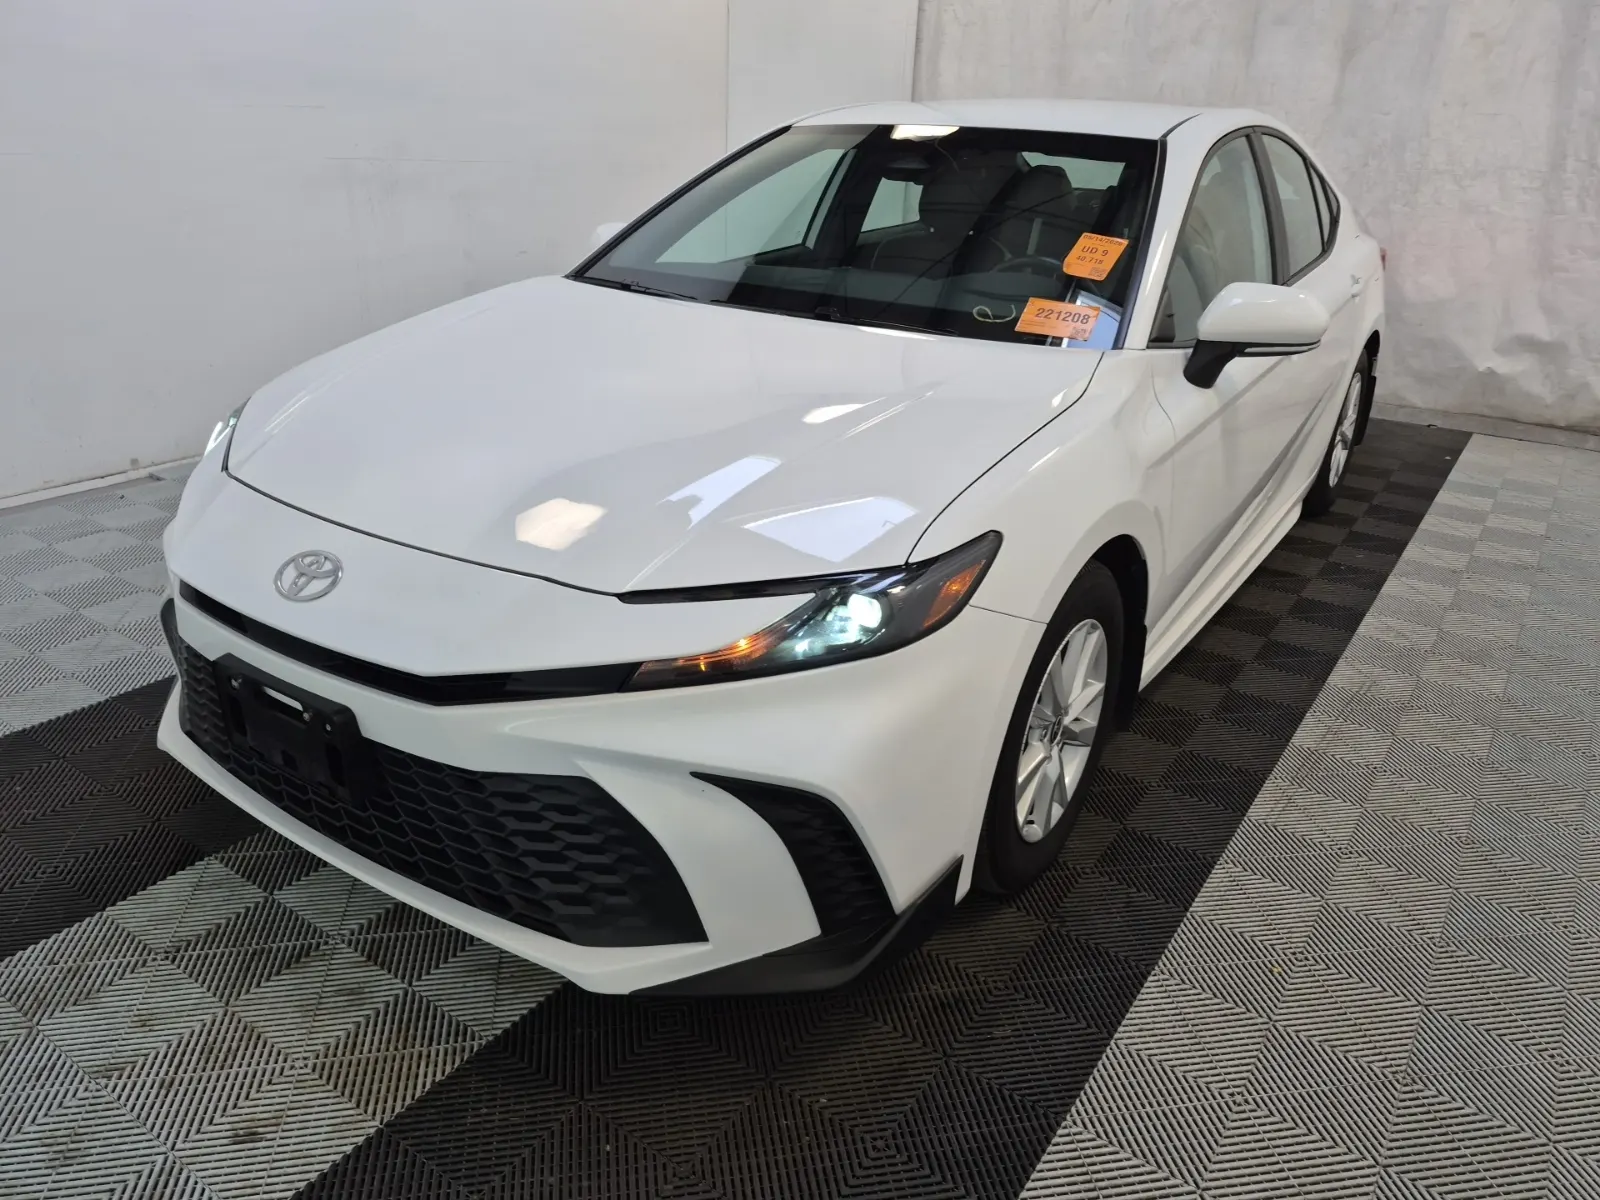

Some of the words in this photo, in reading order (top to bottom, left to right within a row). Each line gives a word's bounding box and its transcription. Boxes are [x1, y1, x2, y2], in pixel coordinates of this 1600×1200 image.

[1081, 246, 1098, 254] UD
[1101, 249, 1109, 257] 9
[1035, 307, 1091, 324] 221208
